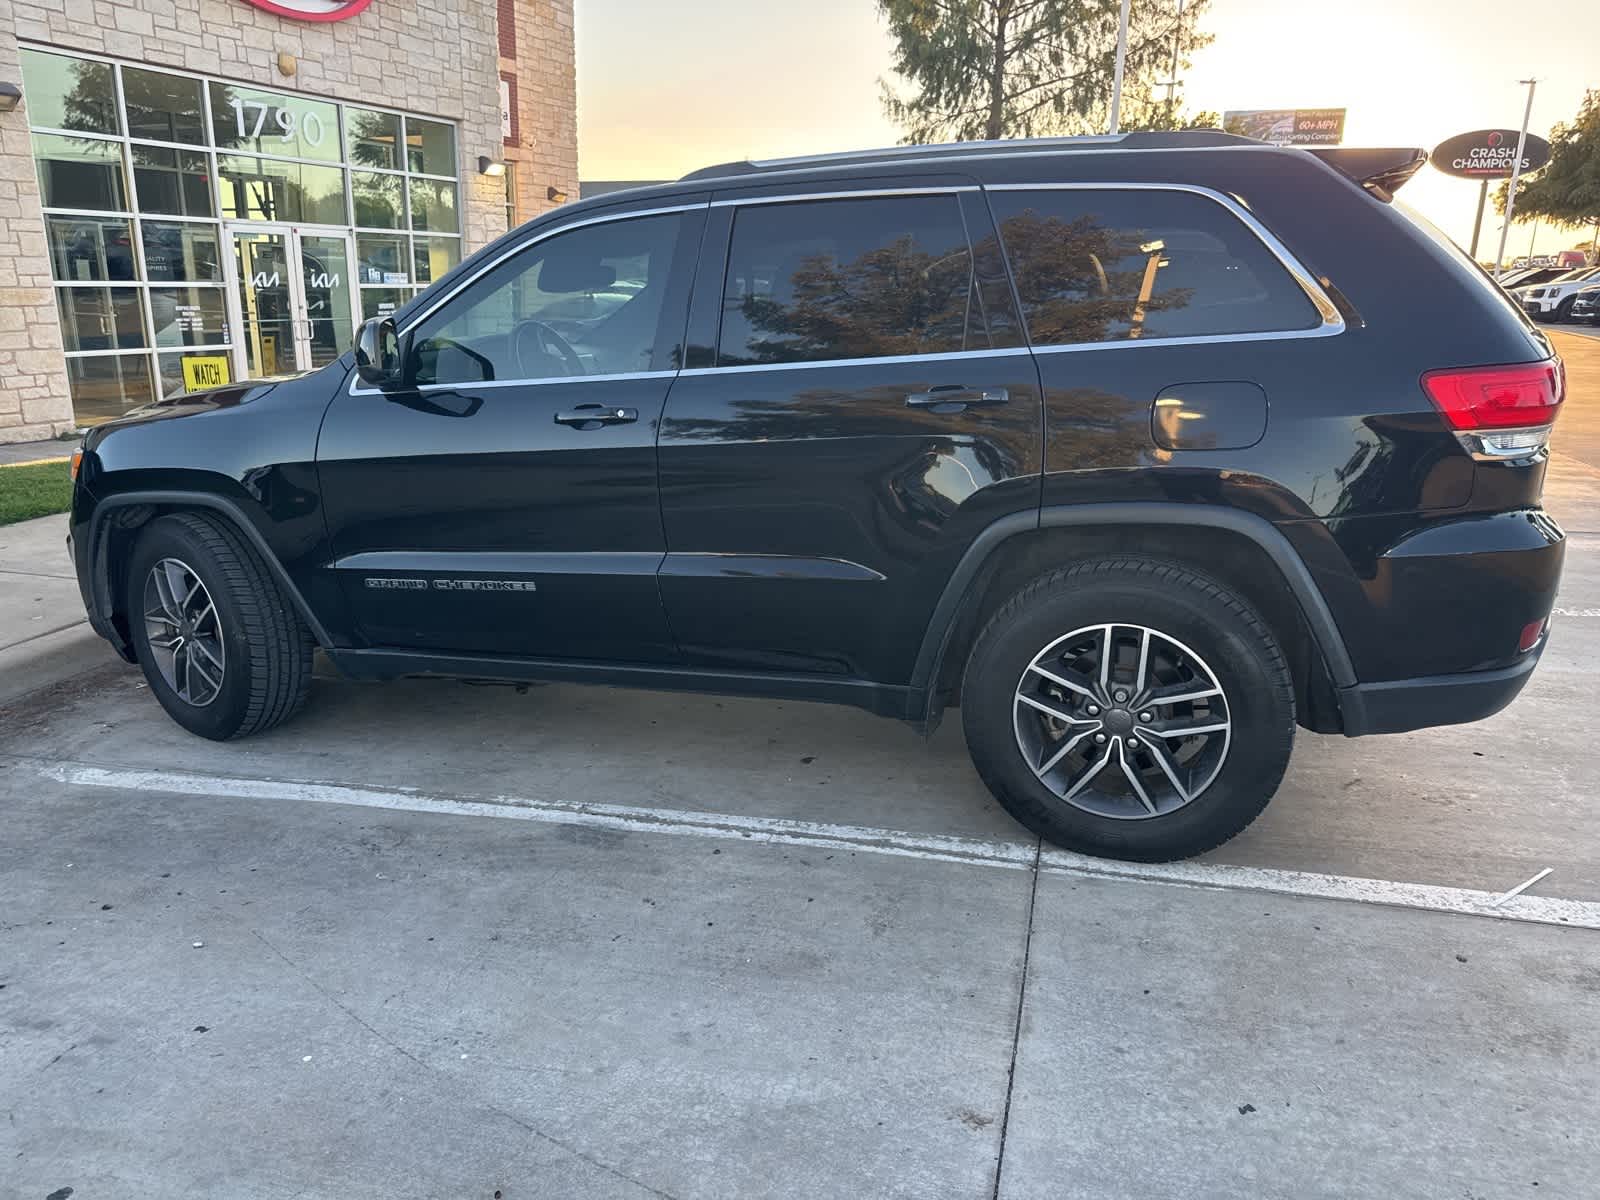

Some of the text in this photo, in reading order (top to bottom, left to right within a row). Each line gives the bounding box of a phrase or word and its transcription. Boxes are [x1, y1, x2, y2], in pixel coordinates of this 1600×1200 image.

[227, 98, 324, 147] 1790
[1298, 119, 1339, 130] 60+ MPH
[1470, 148, 1516, 158] CRASH
[192, 363, 222, 385] WATCH
[433, 579, 537, 592] CHEROKEE
